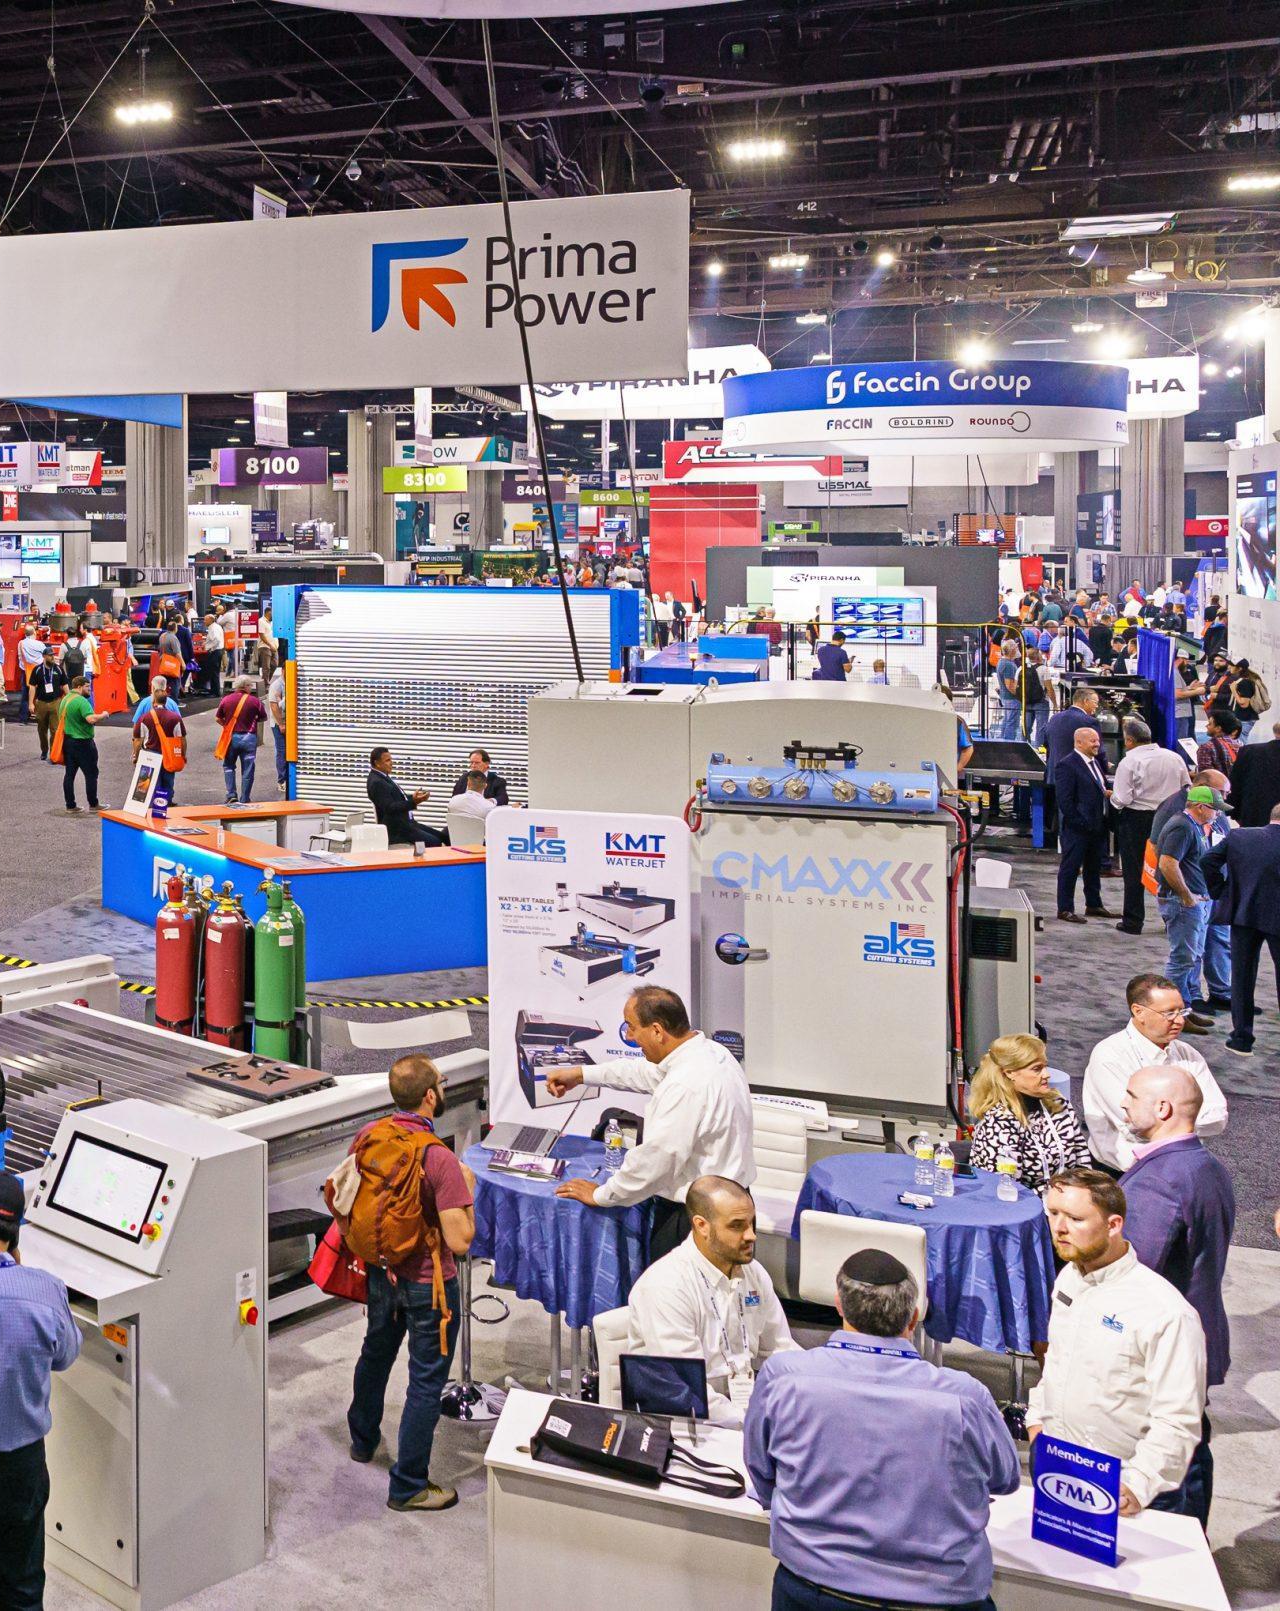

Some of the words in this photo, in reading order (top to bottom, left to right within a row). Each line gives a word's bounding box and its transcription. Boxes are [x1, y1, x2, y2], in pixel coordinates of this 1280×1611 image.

[487, 233, 637, 282] Prima
[486, 284, 656, 329] Power
[853, 370, 940, 393] Faccin
[949, 368, 1031, 398] Group
[826, 417, 873, 430] FACCIN
[893, 417, 950, 428] BOLDRINI
[37, 445, 60, 462] KMT
[433, 446, 458, 459] OW
[246, 456, 300, 475] 8100
[403, 472, 447, 487] 8300
[593, 493, 620, 501] 8600
[508, 825, 566, 855] aks
[605, 832, 666, 853] KMT
[606, 857, 666, 869] WATERJET
[712, 850, 893, 899] CMAXX
[498, 896, 531, 904] WATERJET
[532, 897, 555, 905] TABLES
[500, 903, 511, 911] X2
[520, 904, 532, 912] X3
[541, 905, 553, 913] X4
[712, 890, 795, 905] IMPERIAL
[806, 897, 886, 911] SYSTEMS
[897, 904, 936, 915] INC.
[864, 921, 935, 958] aks
[867, 954, 896, 964] CUTTING
[897, 956, 933, 967] SYSTEMS
[624, 1050, 645, 1058] GENER
[1046, 1443, 1096, 1469] Member
[1097, 1462, 1111, 1473] of
[1055, 1479, 1096, 1507] FMA
